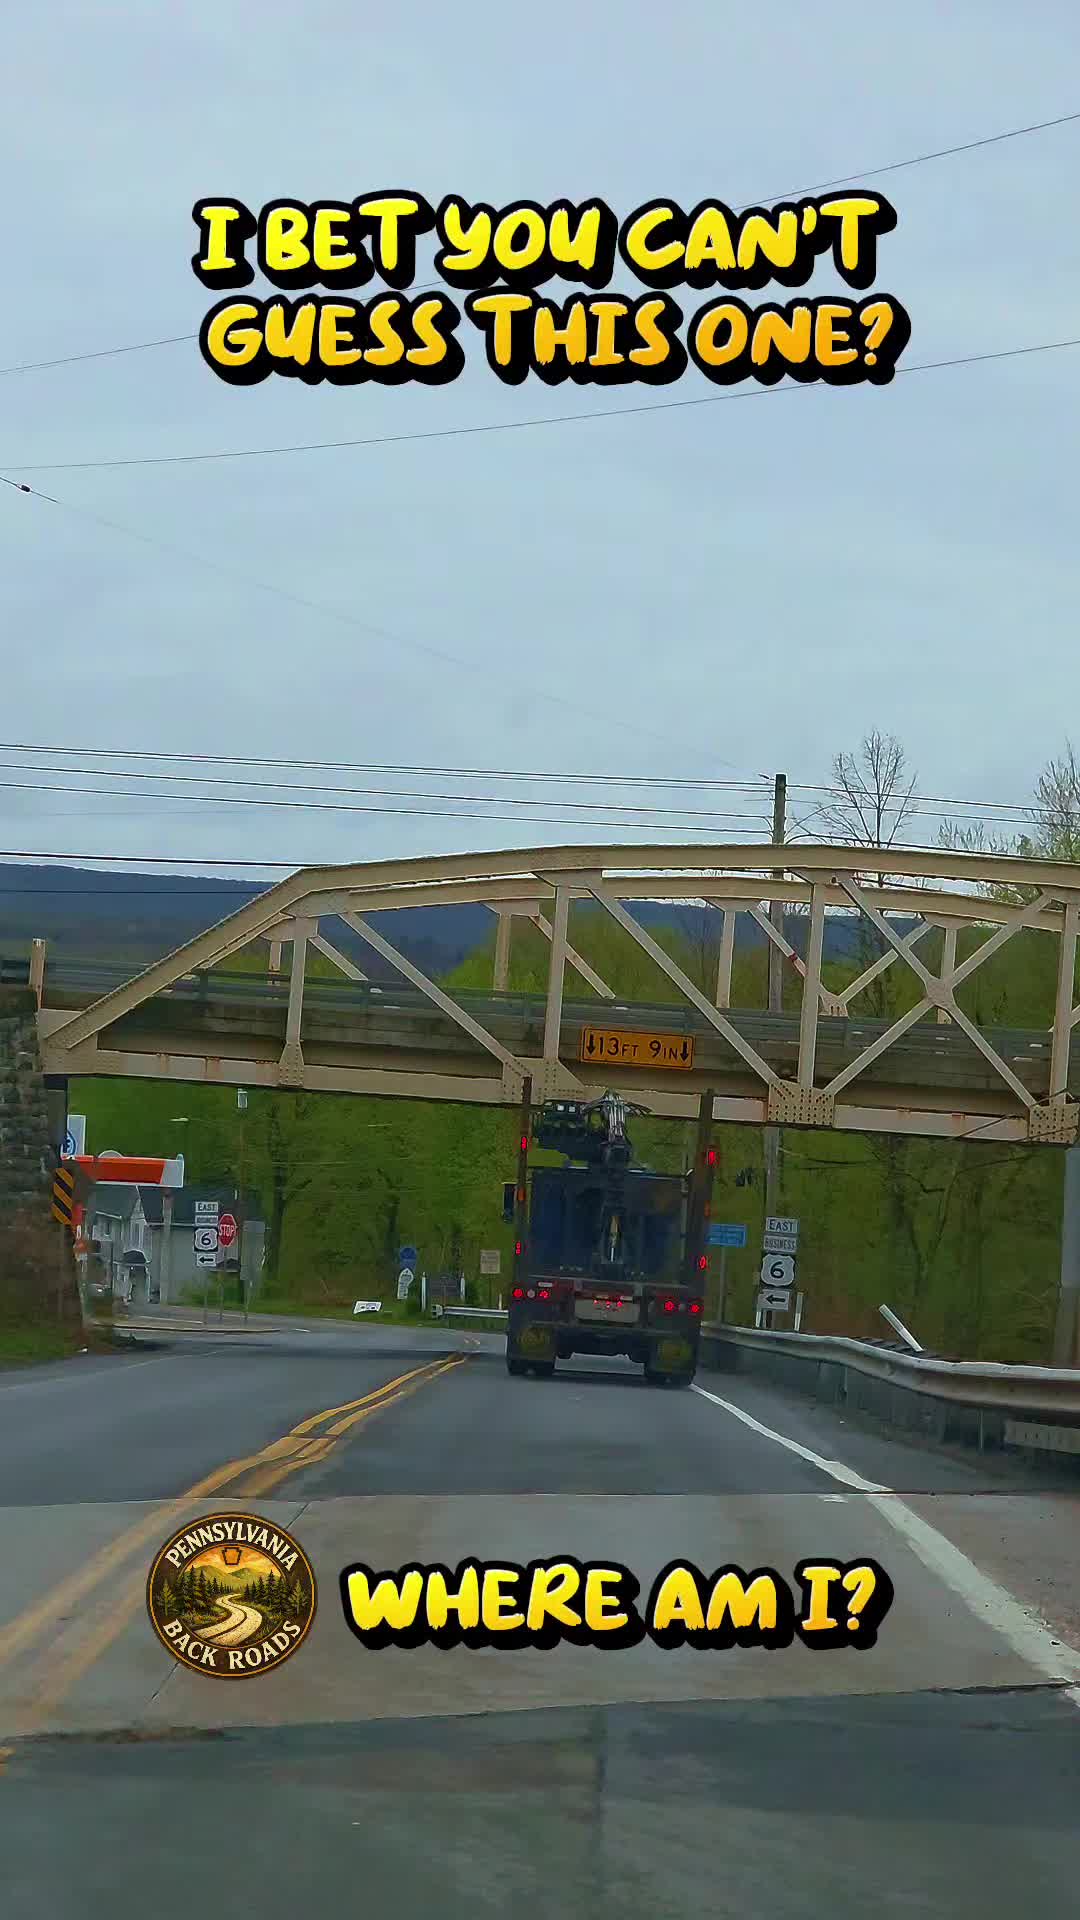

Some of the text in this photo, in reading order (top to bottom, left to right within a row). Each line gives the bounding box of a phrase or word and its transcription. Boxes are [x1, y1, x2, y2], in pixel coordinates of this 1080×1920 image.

[197, 1203, 217, 1211] EAST
[219, 1224, 235, 1237] STOP
[769, 1220, 794, 1232] EAST
[201, 1233, 211, 1246] 6
[764, 1237, 796, 1250] BUSINESS
[770, 1261, 785, 1279] 6
